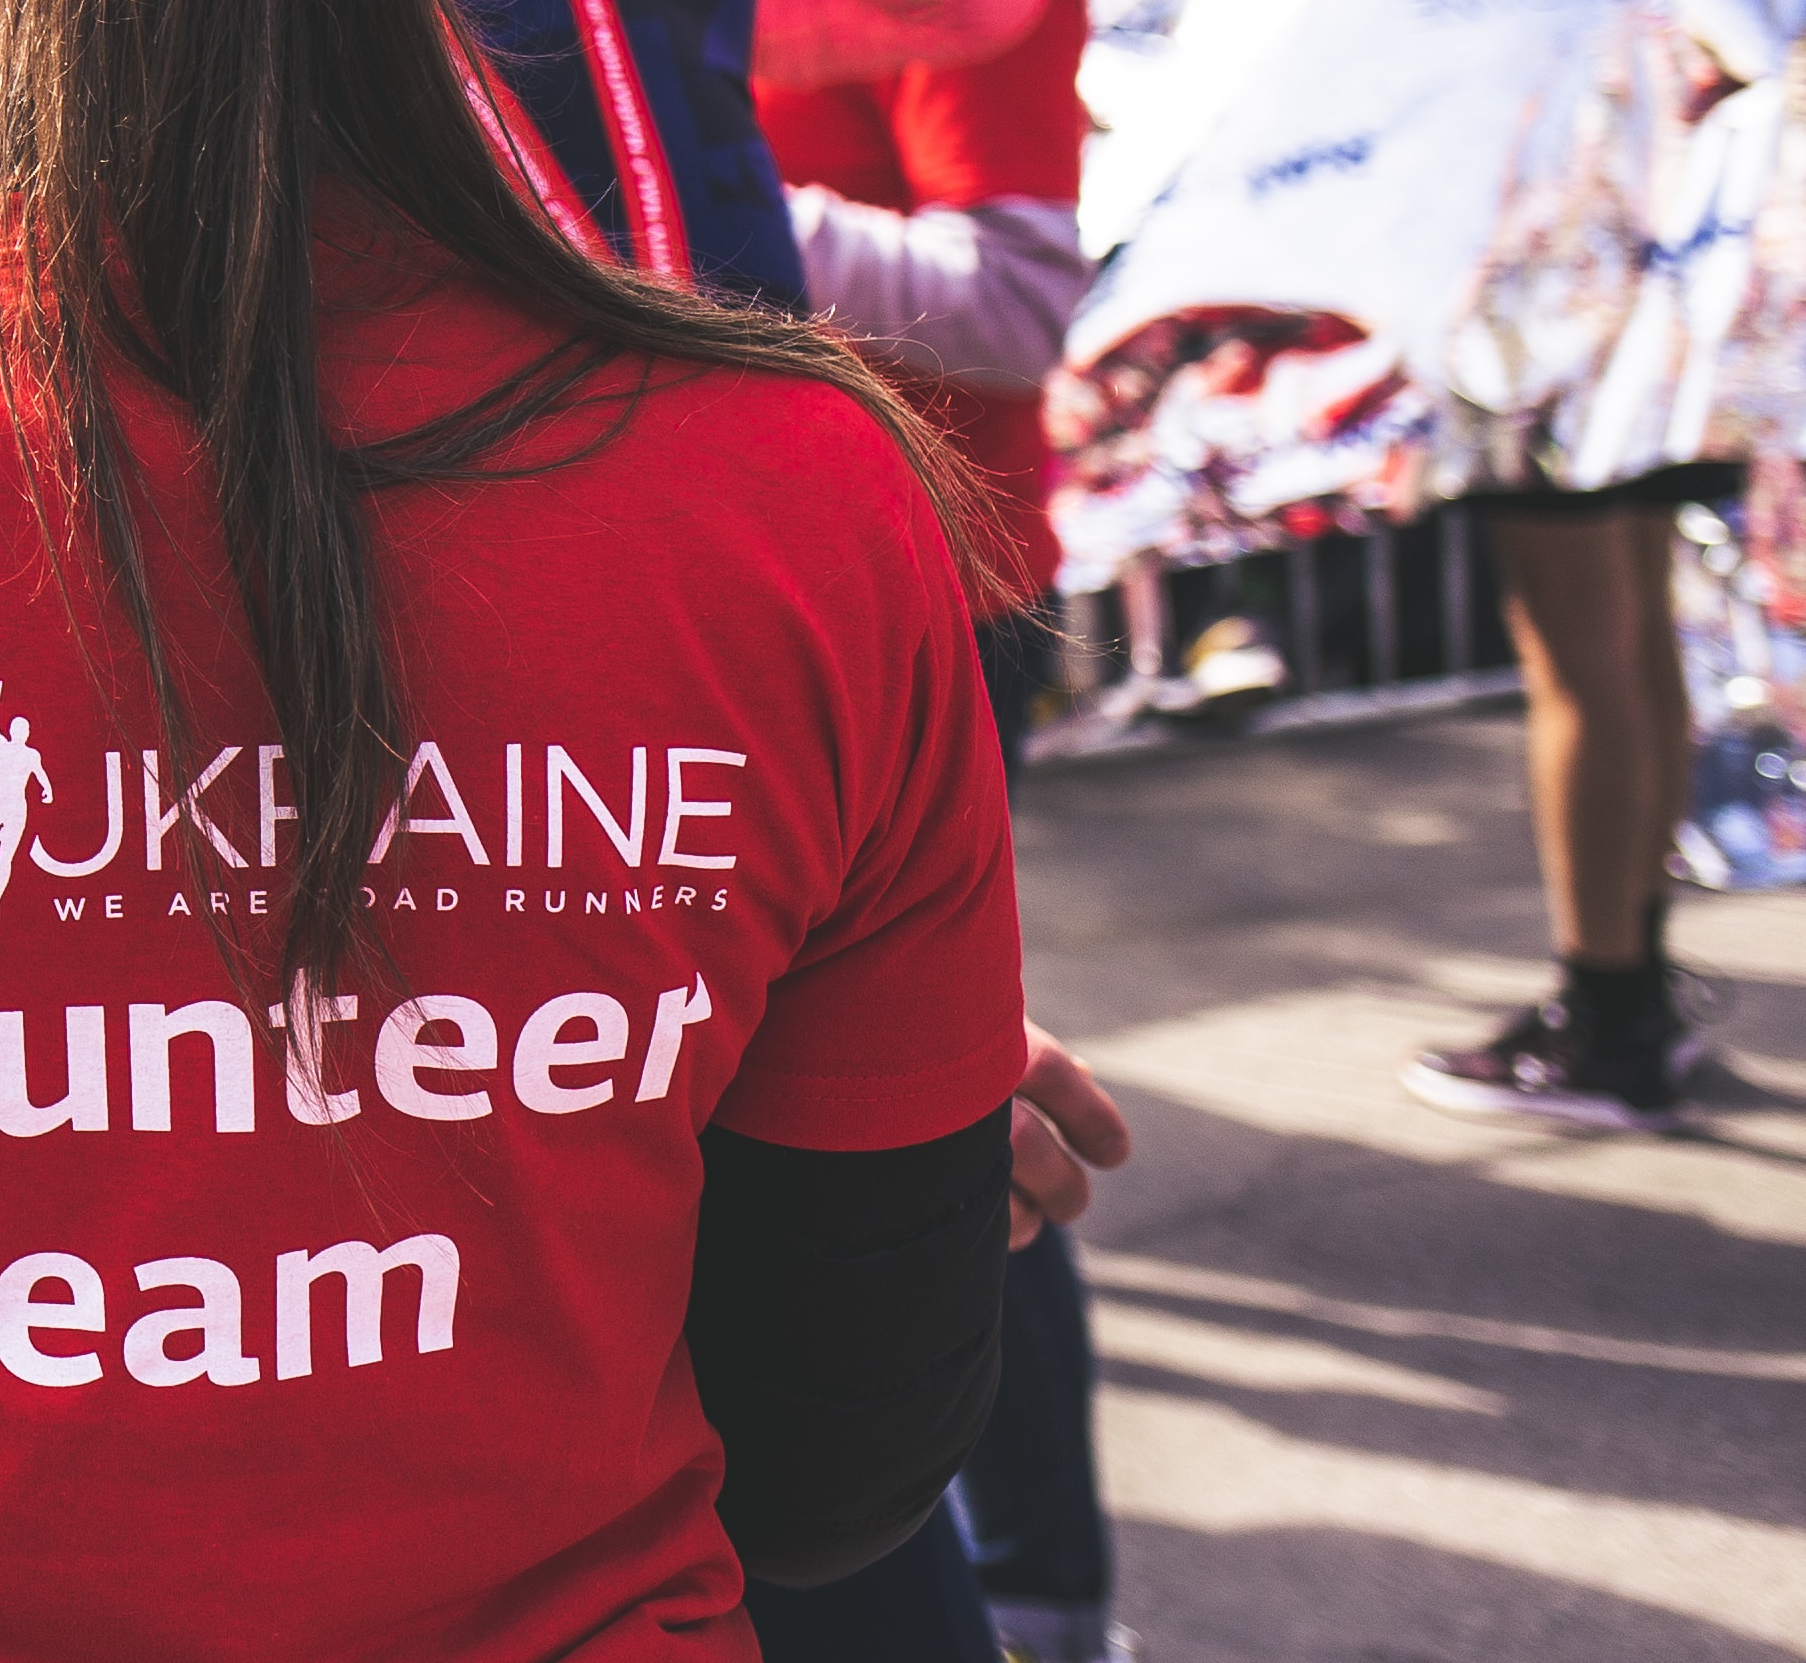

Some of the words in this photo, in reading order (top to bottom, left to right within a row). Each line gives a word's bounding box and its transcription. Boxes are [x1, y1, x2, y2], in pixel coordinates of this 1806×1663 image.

[53, 894, 124, 922] WE
[167, 889, 269, 917] ARE
[504, 883, 730, 915] RUNNERS
